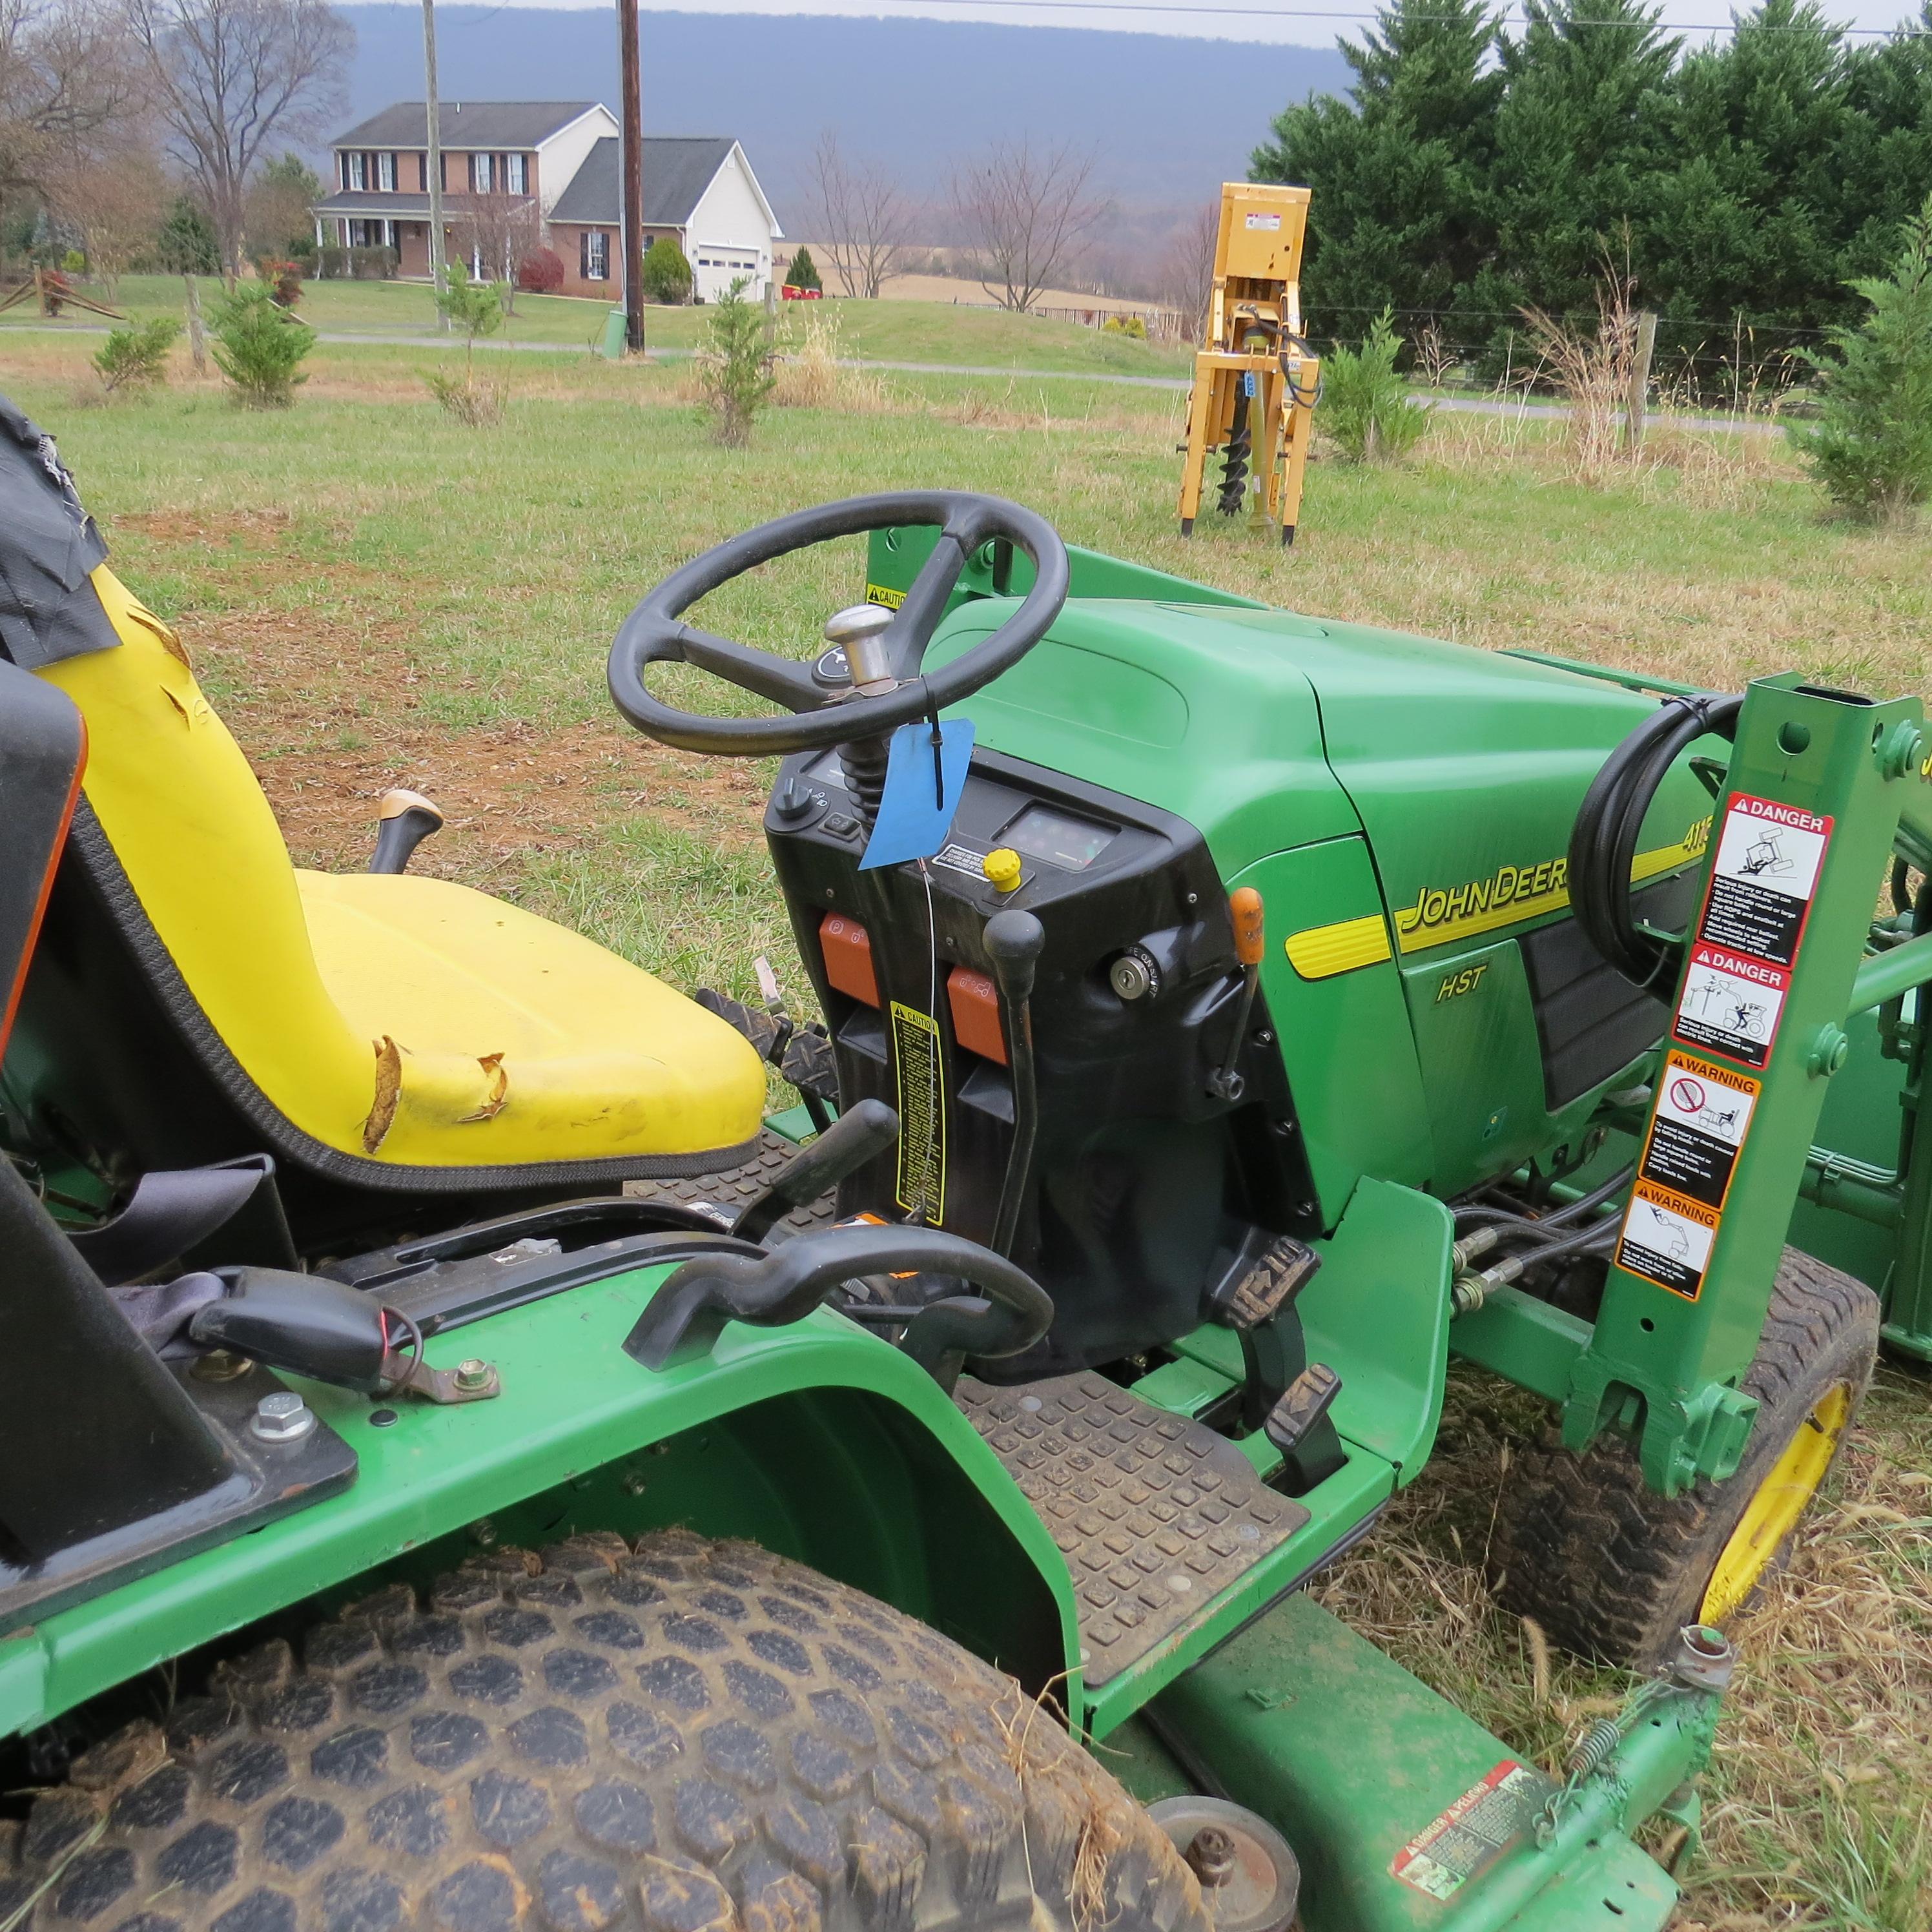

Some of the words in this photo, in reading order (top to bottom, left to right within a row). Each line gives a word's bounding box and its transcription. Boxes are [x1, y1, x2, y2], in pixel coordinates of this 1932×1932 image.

[879, 590, 905, 606] CAUTIO
[1751, 801, 1824, 832] DANGER
[1401, 877, 1490, 932] JOHN
[1492, 857, 1568, 910] DEER
[1141, 954, 1153, 967] ON
[1711, 956, 1782, 986] DANGER
[1437, 965, 1487, 1003] HST
[1685, 1058, 1754, 1093] WARNING
[1652, 1189, 1714, 1226] WARNING
